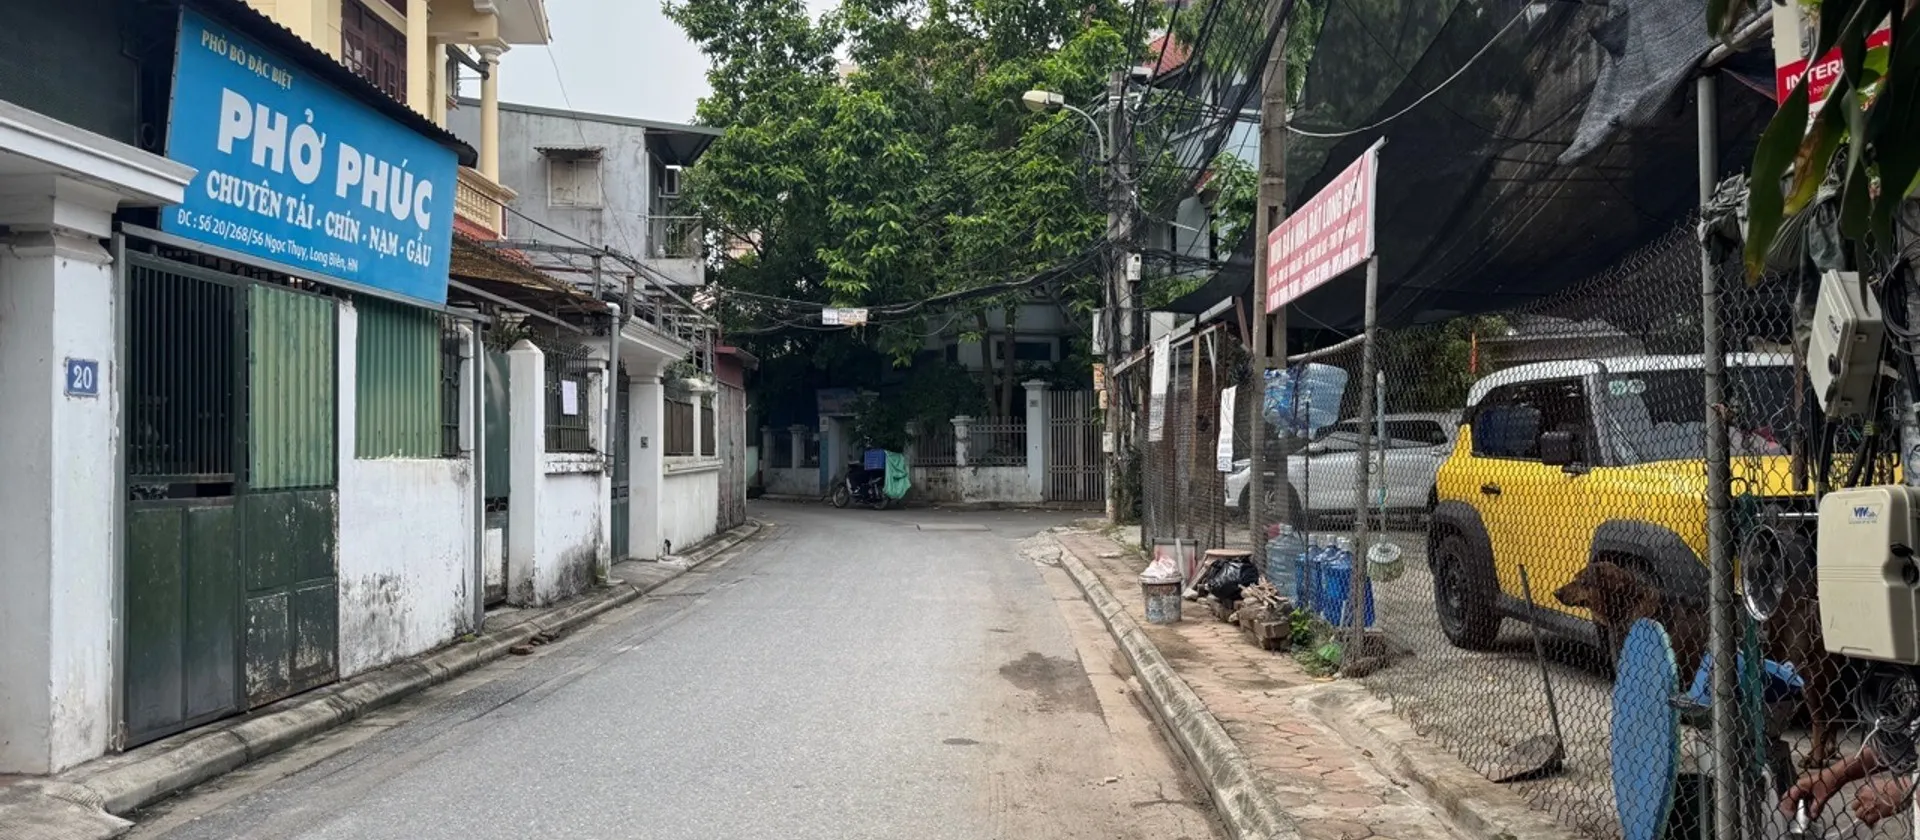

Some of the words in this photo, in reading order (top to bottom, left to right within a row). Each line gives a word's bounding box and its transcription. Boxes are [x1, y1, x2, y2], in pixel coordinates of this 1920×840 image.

[201, 29, 228, 56] PHỞ
[229, 44, 246, 66] BÒ
[248, 54, 270, 78] ĐẶC
[271, 66, 293, 90] BIỆT
[1786, 60, 1841, 91] INTER
[217, 87, 326, 185] PHỞ
[336, 141, 433, 230] PHÚC
[206, 169, 283, 219] CHUYÊN
[286, 193, 314, 230] TÁI
[325, 210, 360, 245] CHÍN
[369, 225, 398, 259] NẠM
[1323, 188, 1343, 230] LONG
[198, 213, 212, 231] Số
[212, 218, 264, 246] 20/268/56
[264, 233, 286, 253] Ngọc
[288, 239, 309, 261] Thụy,
[309, 246, 328, 268] Long
[329, 252, 346, 272] Biên,
[347, 257, 358, 272] HN
[73, 365, 92, 389] 20
